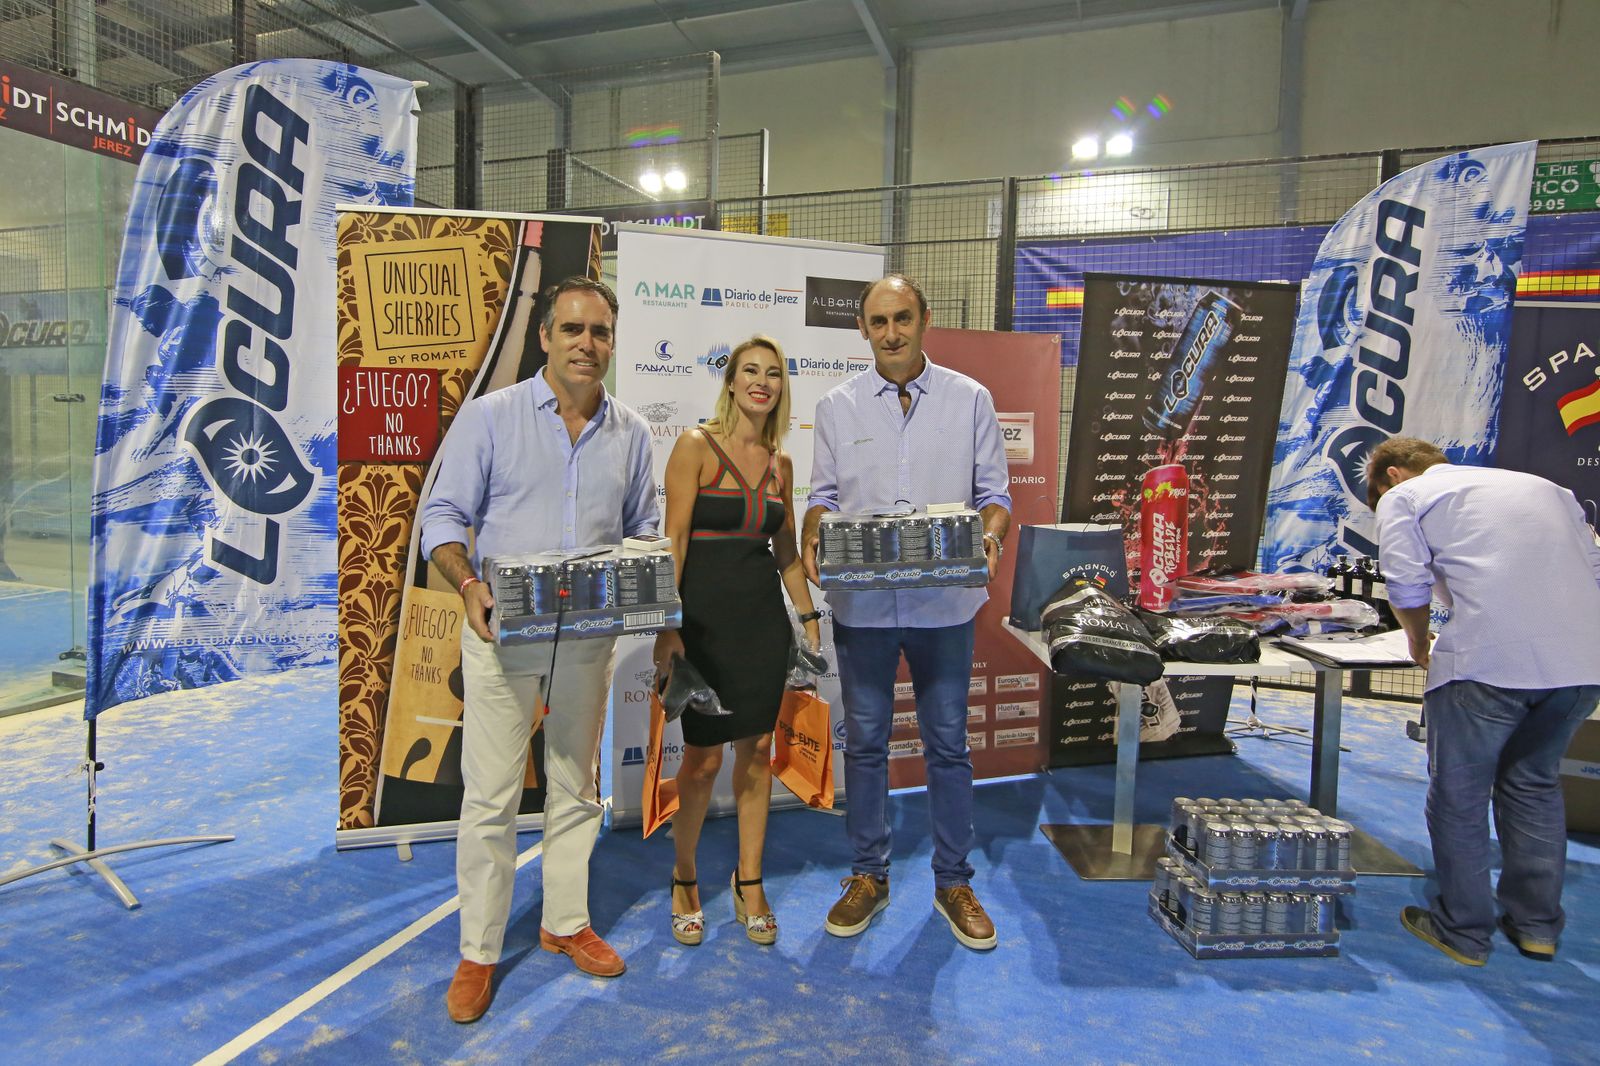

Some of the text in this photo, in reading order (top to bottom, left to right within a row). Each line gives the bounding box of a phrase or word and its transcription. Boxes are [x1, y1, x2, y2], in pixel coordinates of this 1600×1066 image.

[93, 136, 132, 158] JEREZ
[383, 261, 461, 297] UNUSUAL
[655, 282, 695, 300] MAR
[724, 288, 799, 305] Diario de Jerez
[642, 299, 688, 308] RESTAURANTE
[725, 301, 770, 310] PADEL CUP
[1114, 307, 1146, 317] LOCURA
[1155, 309, 1186, 319] LOCURA
[382, 303, 461, 337] SHERRIES
[184, 84, 315, 585] LOCURA
[1112, 328, 1143, 338] LOCURA
[1152, 330, 1182, 340] LOCURA
[388, 349, 467, 365] BY ROMATE
[1109, 349, 1141, 359] LOCURA
[1227, 354, 1258, 363] LOCURA
[801, 357, 869, 374] Diario de Jerez
[1163, 311, 1220, 413] LOCURA
[635, 364, 693, 374] FANAUTIC
[800, 369, 827, 377] PADEL
[1107, 370, 1138, 380] LOCURA
[1225, 374, 1255, 383] LOCURA
[342, 372, 431, 414] ¿FUEGO?
[1104, 391, 1136, 401] LOCURA
[1222, 394, 1252, 403] LOCURA
[1102, 411, 1133, 421] LOCURA
[1219, 414, 1249, 423] LOCURA
[385, 412, 404, 433] NO
[368, 436, 421, 456] THANKS
[1011, 475, 1046, 485] DIARIO
[885, 571, 921, 580] LOCURA
[933, 567, 969, 576] LOCURA
[1062, 563, 1117, 580] SPAGNOLO
[403, 603, 458, 642] ¿FUEGO?
[421, 646, 433, 664] NO
[411, 663, 442, 685] THANKS
